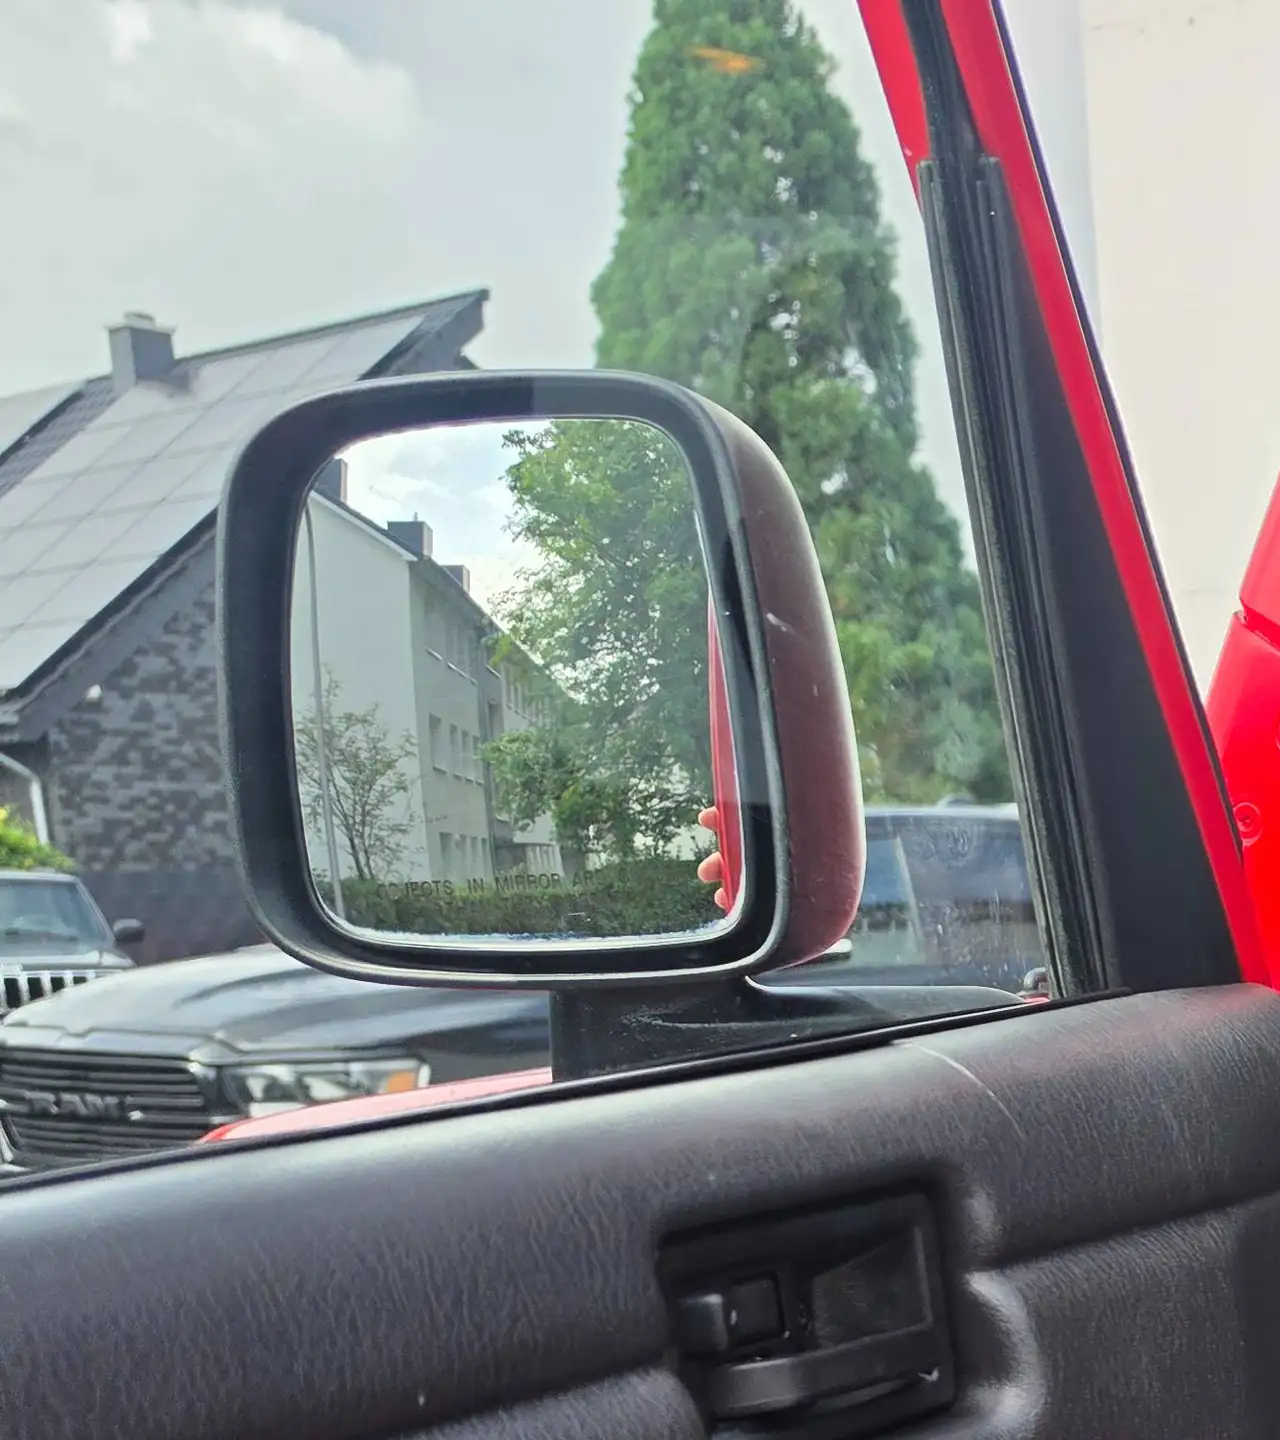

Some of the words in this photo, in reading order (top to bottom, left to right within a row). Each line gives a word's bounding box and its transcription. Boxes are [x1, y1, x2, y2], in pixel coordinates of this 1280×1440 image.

[467, 877, 485, 895] IN
[494, 872, 562, 893] MIRROR
[25, 1090, 124, 1119] RAM
